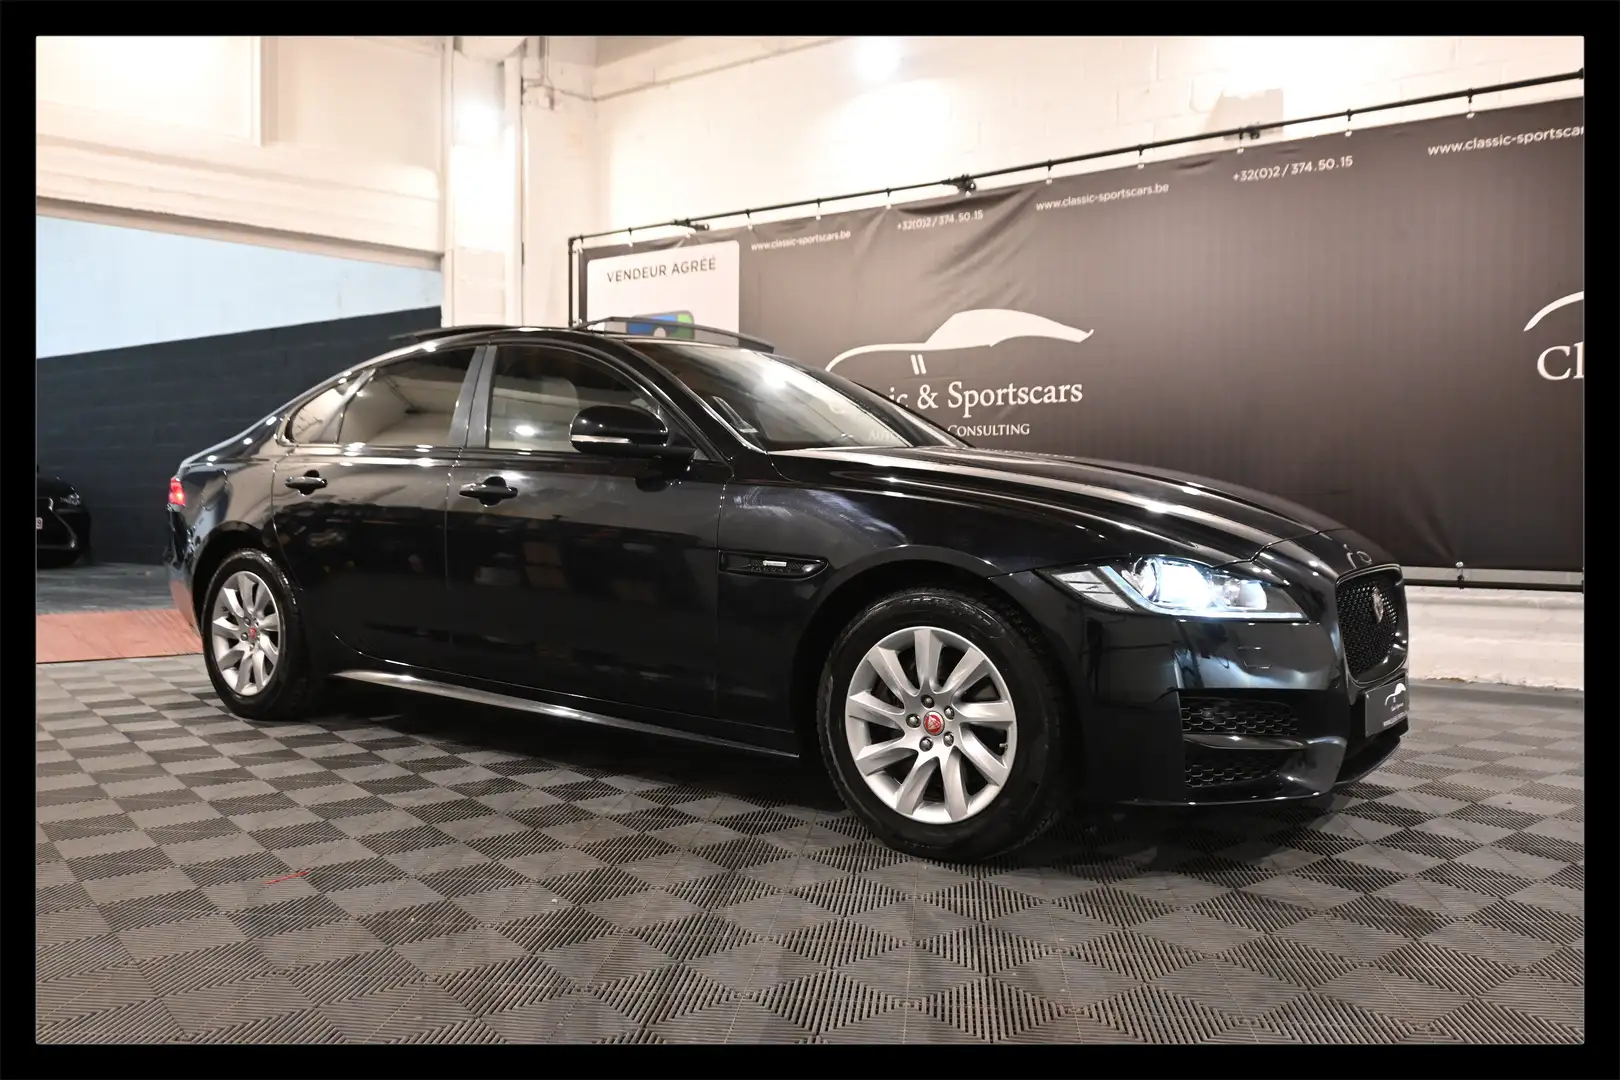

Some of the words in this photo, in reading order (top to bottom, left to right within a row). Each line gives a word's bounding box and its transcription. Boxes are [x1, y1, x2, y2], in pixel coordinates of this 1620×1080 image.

[1036, 182, 1170, 211] www.classic-sportscars.be
[751, 230, 851, 251] www.classic-sportscars.be
[606, 264, 667, 283] VENDEUR
[671, 257, 716, 276] AGRÉÉ
[917, 384, 939, 410] &
[948, 381, 1083, 418] Sportscars
[948, 423, 1030, 437] CONSULTING
